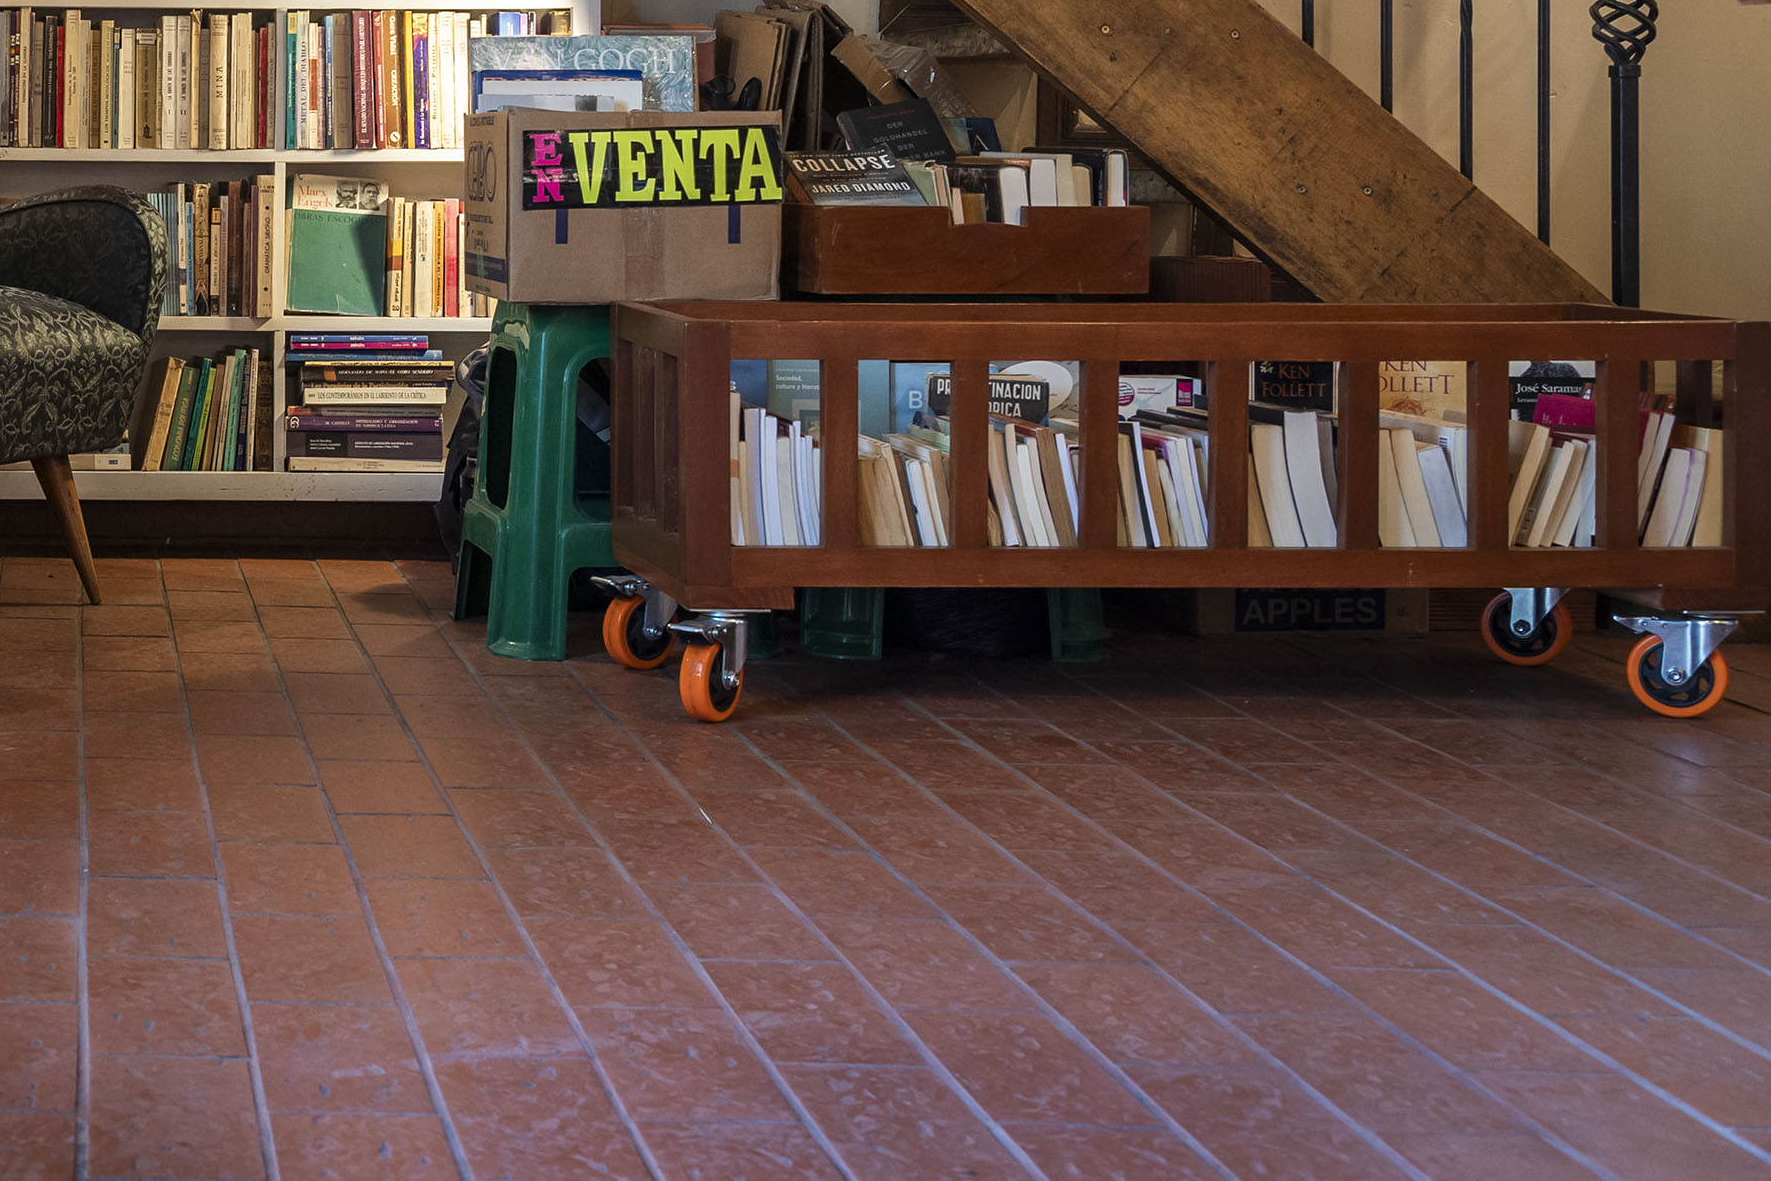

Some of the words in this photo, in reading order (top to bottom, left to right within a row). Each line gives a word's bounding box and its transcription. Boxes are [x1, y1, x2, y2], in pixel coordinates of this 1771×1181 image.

[493, 48, 562, 71] VAN
[573, 47, 677, 75] GOGH
[215, 65, 224, 98] MINA
[886, 121, 905, 129] DER
[873, 129, 929, 144] GOLDHANDEL
[897, 143, 915, 152] DER
[568, 127, 783, 204] VENTA
[791, 153, 896, 173] COLLAPSE
[298, 184, 328, 197] Marx
[811, 184, 851, 194] JARED
[854, 181, 911, 193] DIAMOND
[297, 195, 333, 210] Engels
[293, 212, 324, 222] OBRAS
[327, 214, 381, 225] ESCOGIDAS
[1278, 363, 1311, 380] KEN
[1384, 360, 1427, 373] KEN
[1262, 381, 1327, 398] FOLLETT
[1379, 374, 1455, 395] OLLETT
[1515, 383, 1540, 395] José
[326, 391, 364, 399] CONTEMPORÁNEOS
[410, 391, 427, 399] CRÍTICA
[1242, 597, 1378, 625] APPLES
